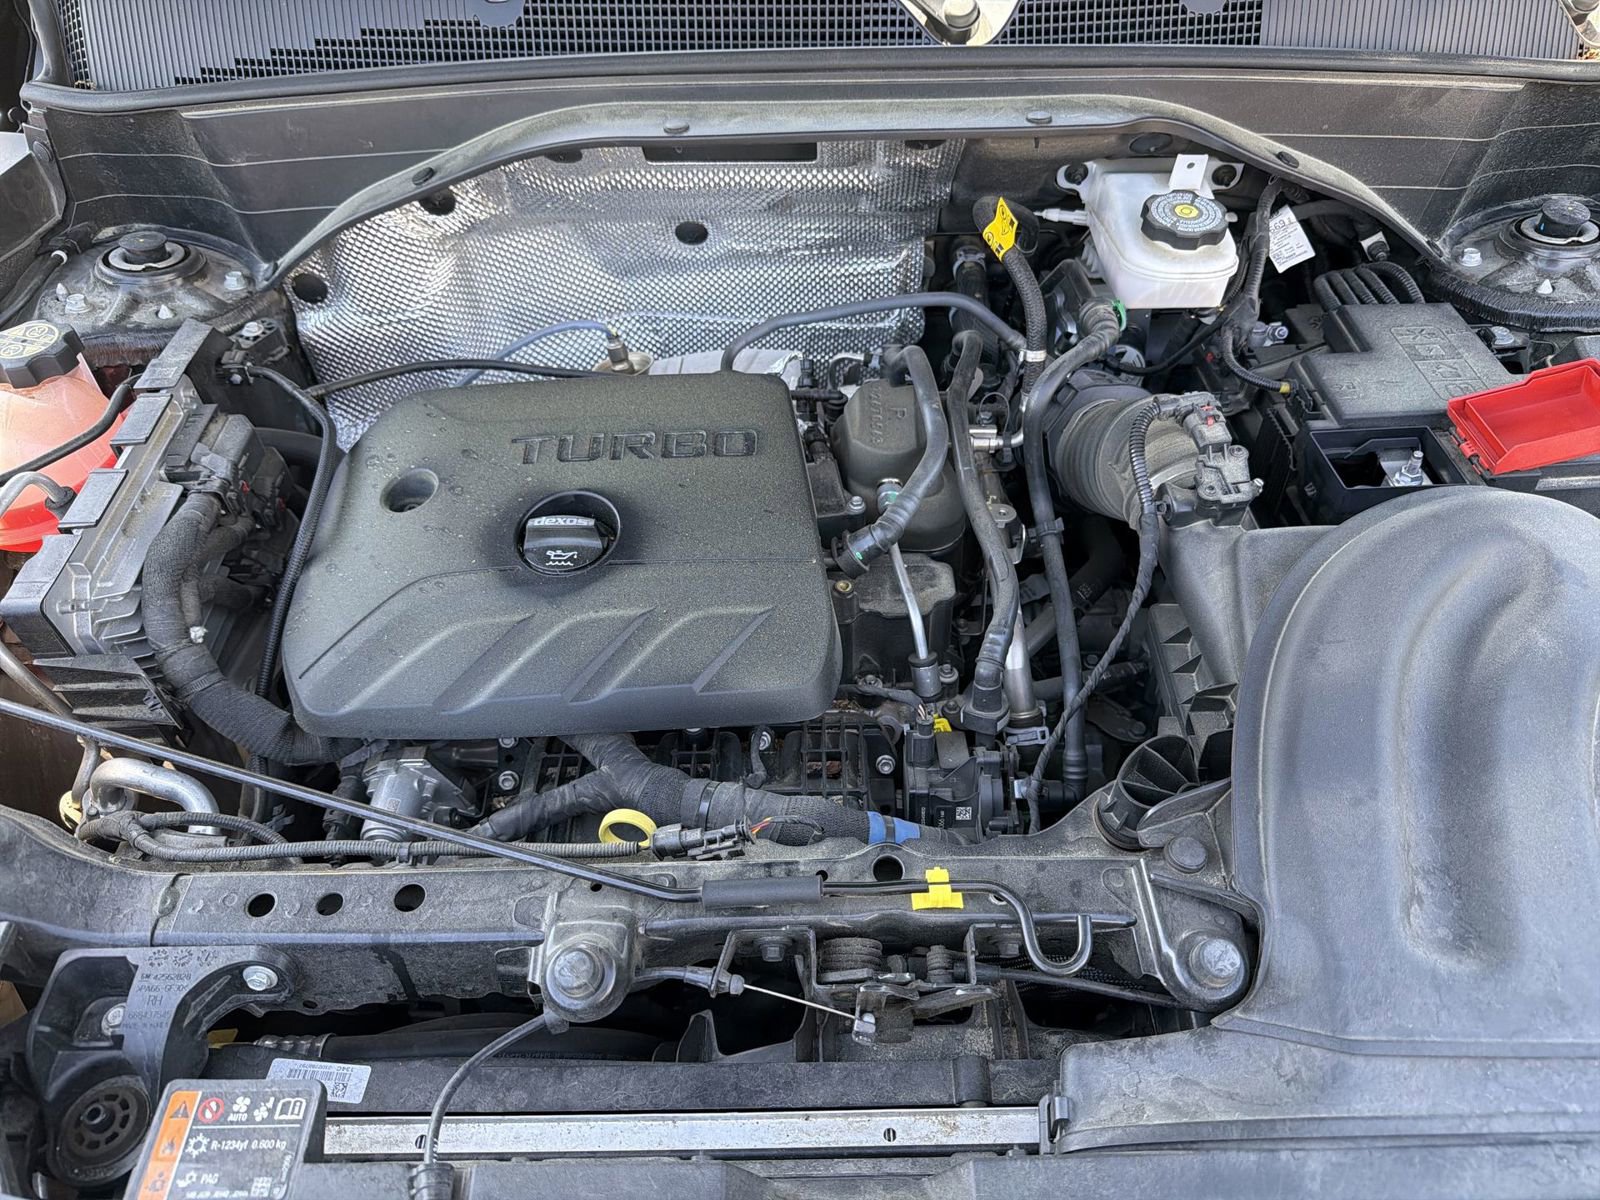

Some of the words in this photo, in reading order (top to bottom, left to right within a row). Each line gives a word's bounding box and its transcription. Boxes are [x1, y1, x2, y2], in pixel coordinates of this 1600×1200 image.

[511, 429, 759, 464] TURBO
[532, 516, 589, 526] dexos
[146, 995, 163, 1006] RH
[227, 1113, 248, 1122] AUTO
[210, 1139, 249, 1152] R-1234yf
[276, 1139, 287, 1151] kg
[201, 1173, 219, 1184] PAG
